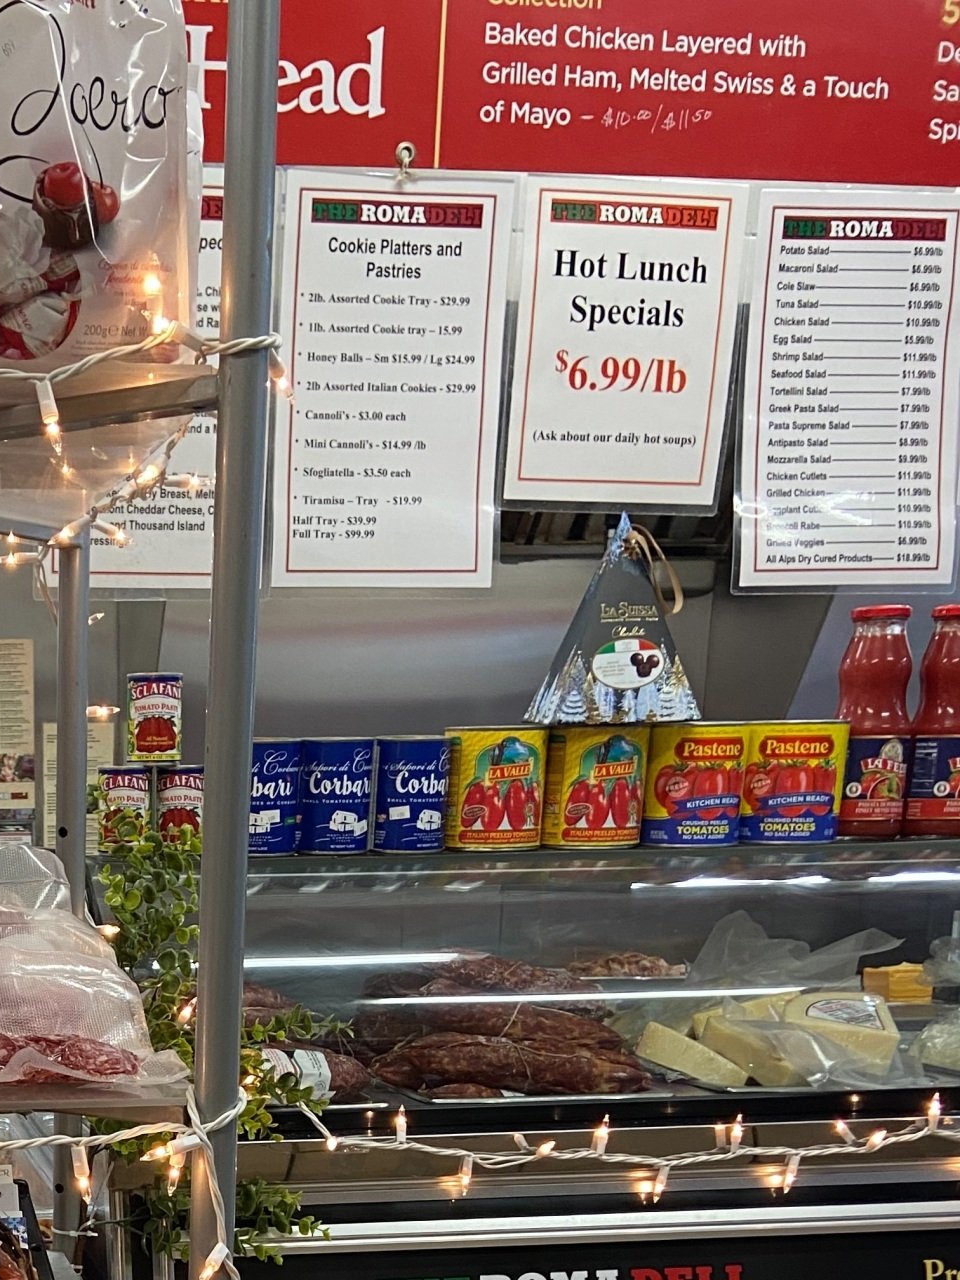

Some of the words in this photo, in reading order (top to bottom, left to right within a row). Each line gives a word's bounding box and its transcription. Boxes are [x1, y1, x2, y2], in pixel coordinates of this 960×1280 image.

[485, 22, 557, 47] Baked
[565, 26, 654, 51] Chicken
[661, 30, 752, 57] Layered
[759, 34, 806, 57] with
[482, 62, 557, 86] Grilled
[564, 65, 622, 92] Ham,
[630, 68, 706, 91] Melted
[713, 71, 774, 95] Swiss
[780, 74, 796, 96] &
[803, 80, 816, 96] a
[824, 76, 889, 99] Touch
[480, 100, 505, 122] of
[510, 102, 571, 129] Mayo
[314, 203, 358, 220] THE
[360, 204, 426, 224] ROMA
[429, 208, 481, 225] DELI
[553, 201, 595, 220] THE
[599, 205, 663, 225] ROMA
[667, 208, 718, 227] DELI
[785, 221, 826, 236] THE
[829, 221, 893, 238] ROMA
[897, 223, 945, 238] DELI
[328, 237, 376, 254] Cookie
[380, 239, 432, 256] Platters
[437, 242, 462, 256] and
[366, 262, 421, 279] Pastries
[554, 249, 607, 278] Hot
[616, 252, 708, 284] Lunch
[779, 264, 814, 273] Macaroni
[817, 264, 838, 273] Salad
[328, 294, 369, 304] Assorted
[372, 294, 405, 305] Cookie
[408, 296, 430, 308] Tray
[440, 296, 470, 306] $29.99
[776, 299, 795, 308] Tuna
[797, 300, 819, 309] Salad
[570, 295, 684, 331] Specials
[774, 317, 805, 326] Chicken
[808, 317, 830, 326] Salad
[307, 351, 337, 364] Honey
[340, 353, 363, 363] Balls
[374, 354, 389, 363] Sm
[392, 354, 421, 364] $15.99
[430, 355, 443, 366] Lg
[445, 355, 475, 365] $24.99
[555, 349, 686, 394] $6.99/lb
[305, 410, 350, 420] Cannoli's
[359, 411, 383, 421] $3.00
[385, 412, 406, 421] each
[532, 430, 557, 442] (Ask
[560, 431, 590, 443] about
[593, 433, 611, 443] our
[614, 432, 640, 446] daily
[643, 434, 660, 445] hot
[663, 435, 697, 447] soups)
[303, 467, 354, 478] Sfogliatella
[363, 468, 387, 478] $3.50
[390, 468, 411, 478] each
[127, 505, 166, 515] Cheddar
[168, 505, 205, 516] Cheese,
[129, 521, 175, 531] Thousand
[177, 521, 205, 531] Island
[779, 554, 796, 565] Alps
[798, 555, 811, 565] Dry
[814, 554, 837, 563] Cured
[839, 554, 873, 563] Products
[131, 683, 181, 700] SCLAFANI
[683, 742, 740, 757] Pastene
[766, 740, 829, 754] Pastene
[490, 769, 502, 779] LA
[504, 764, 530, 777] VALLE
[595, 766, 606, 776] LA
[609, 763, 634, 775] VALLE
[687, 798, 719, 808] KITCHEN
[768, 797, 803, 806] KITCHEN
[677, 825, 729, 834] TOMATOES
[759, 823, 815, 831] TOMATOES
